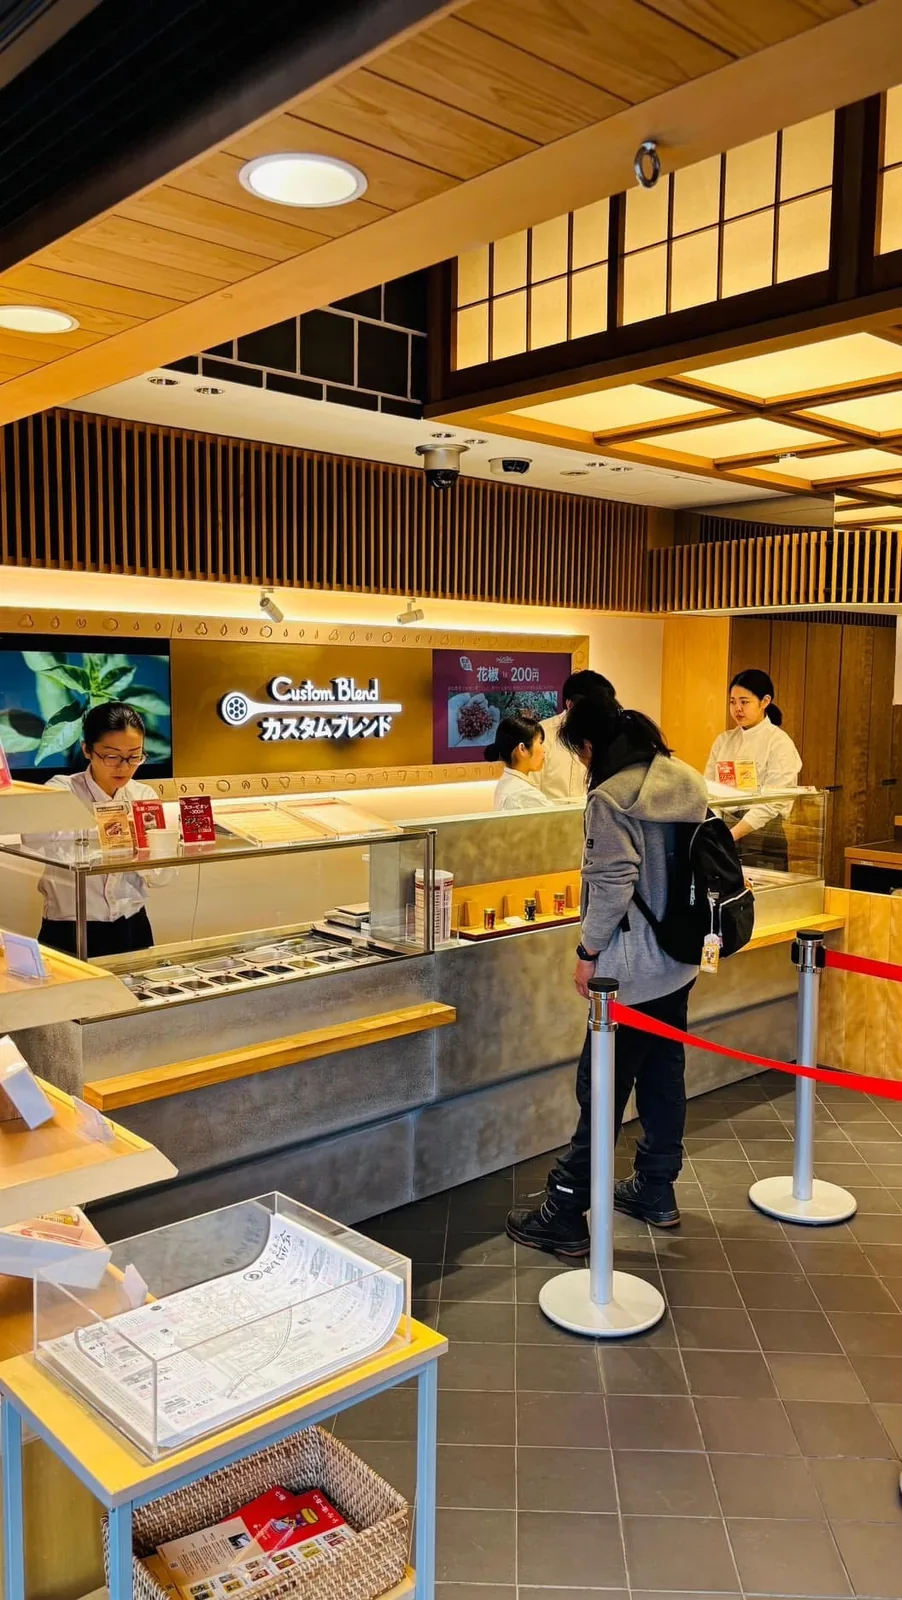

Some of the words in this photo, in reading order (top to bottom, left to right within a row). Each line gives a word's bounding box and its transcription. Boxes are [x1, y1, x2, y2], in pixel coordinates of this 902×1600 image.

[477, 666, 499, 682] 花椒
[511, 667, 539, 682] 200円
[271, 676, 336, 701] Custom
[336, 677, 379, 701] Blend
[263, 714, 393, 741] カスタムブレンド
